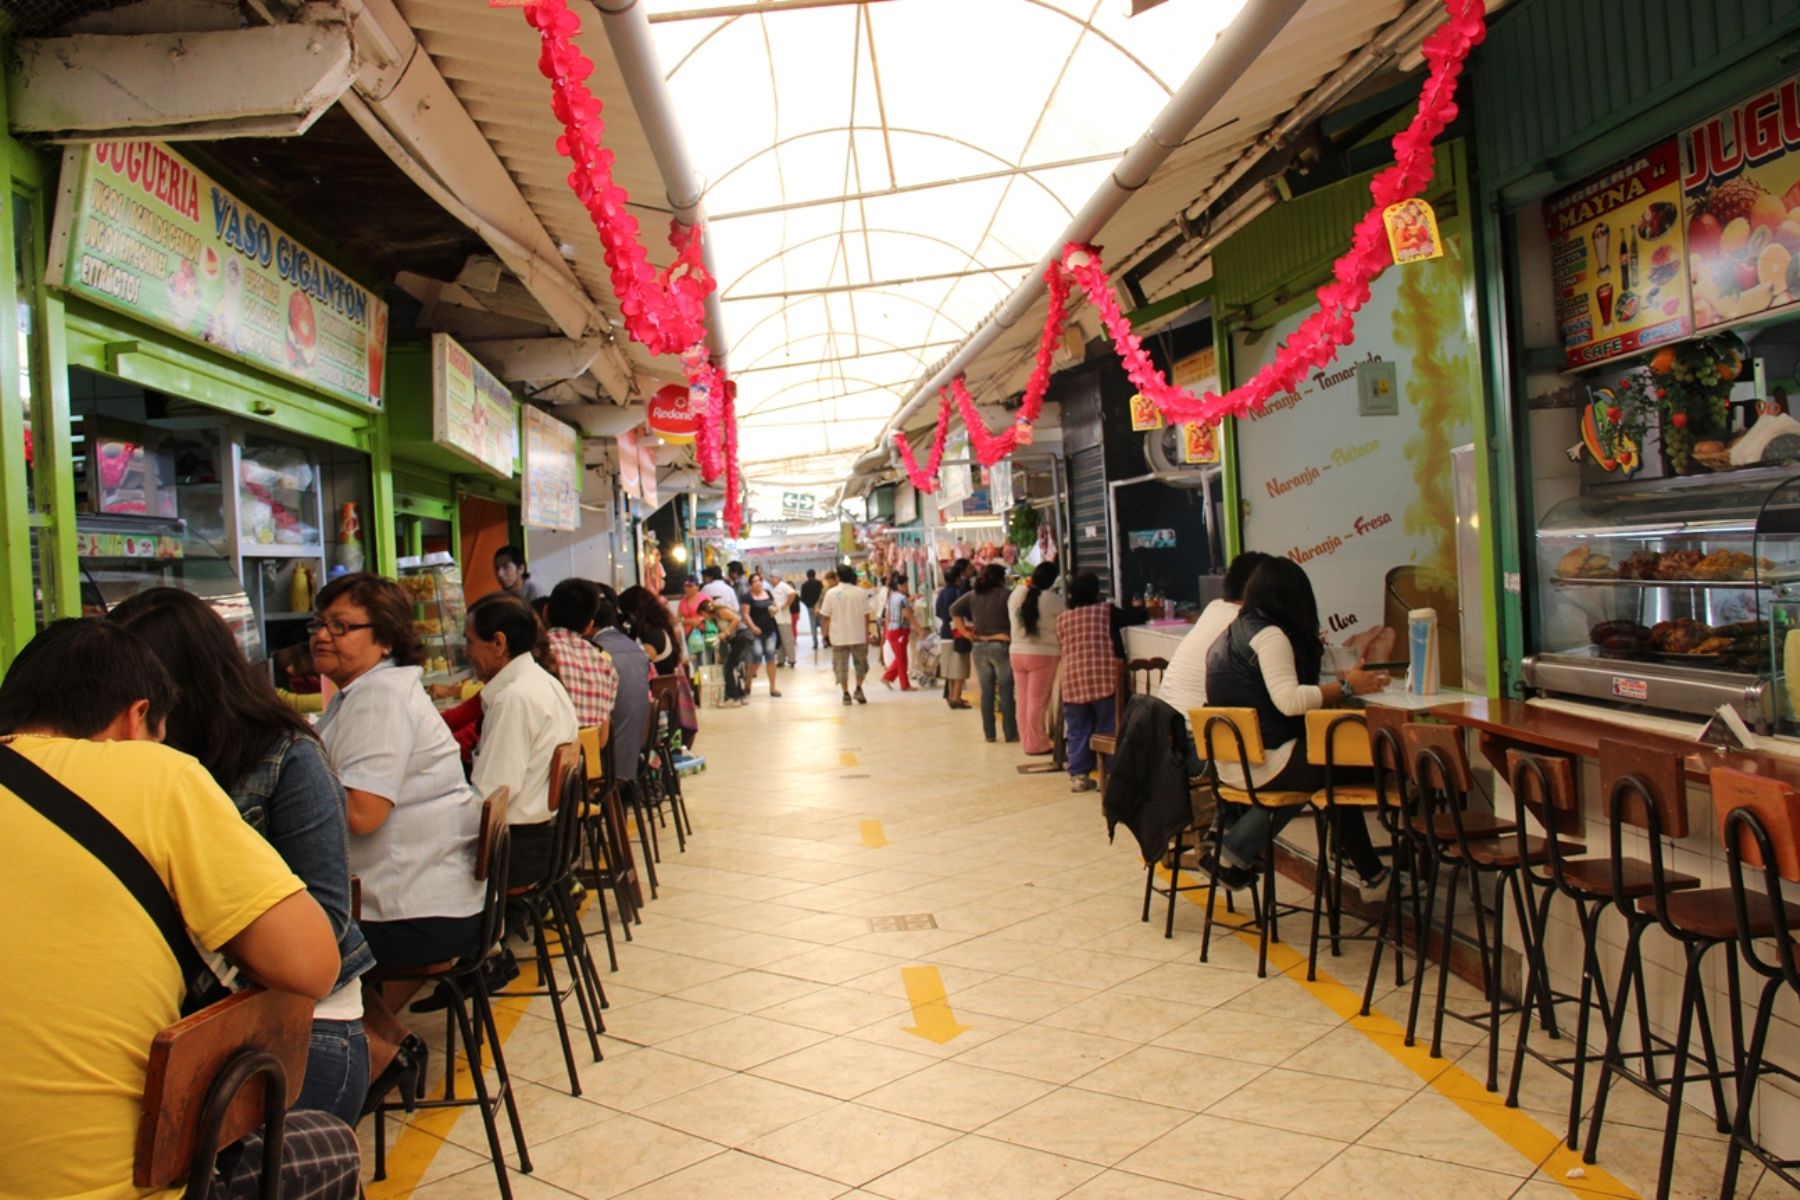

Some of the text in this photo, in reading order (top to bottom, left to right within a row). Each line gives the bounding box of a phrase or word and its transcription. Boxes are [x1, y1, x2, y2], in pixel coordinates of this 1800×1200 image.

[1560, 176, 1647, 229] MAYNA
[211, 186, 271, 267] VASO
[277, 234, 366, 326] GIGANTON
[1583, 338, 1622, 360] CAFE
[1248, 391, 1302, 421] Naranja
[1265, 467, 1320, 498] Naranja
[1288, 536, 1342, 564] Naranja
[1354, 512, 1393, 535] Fresa
[1328, 613, 1358, 632] Uva
